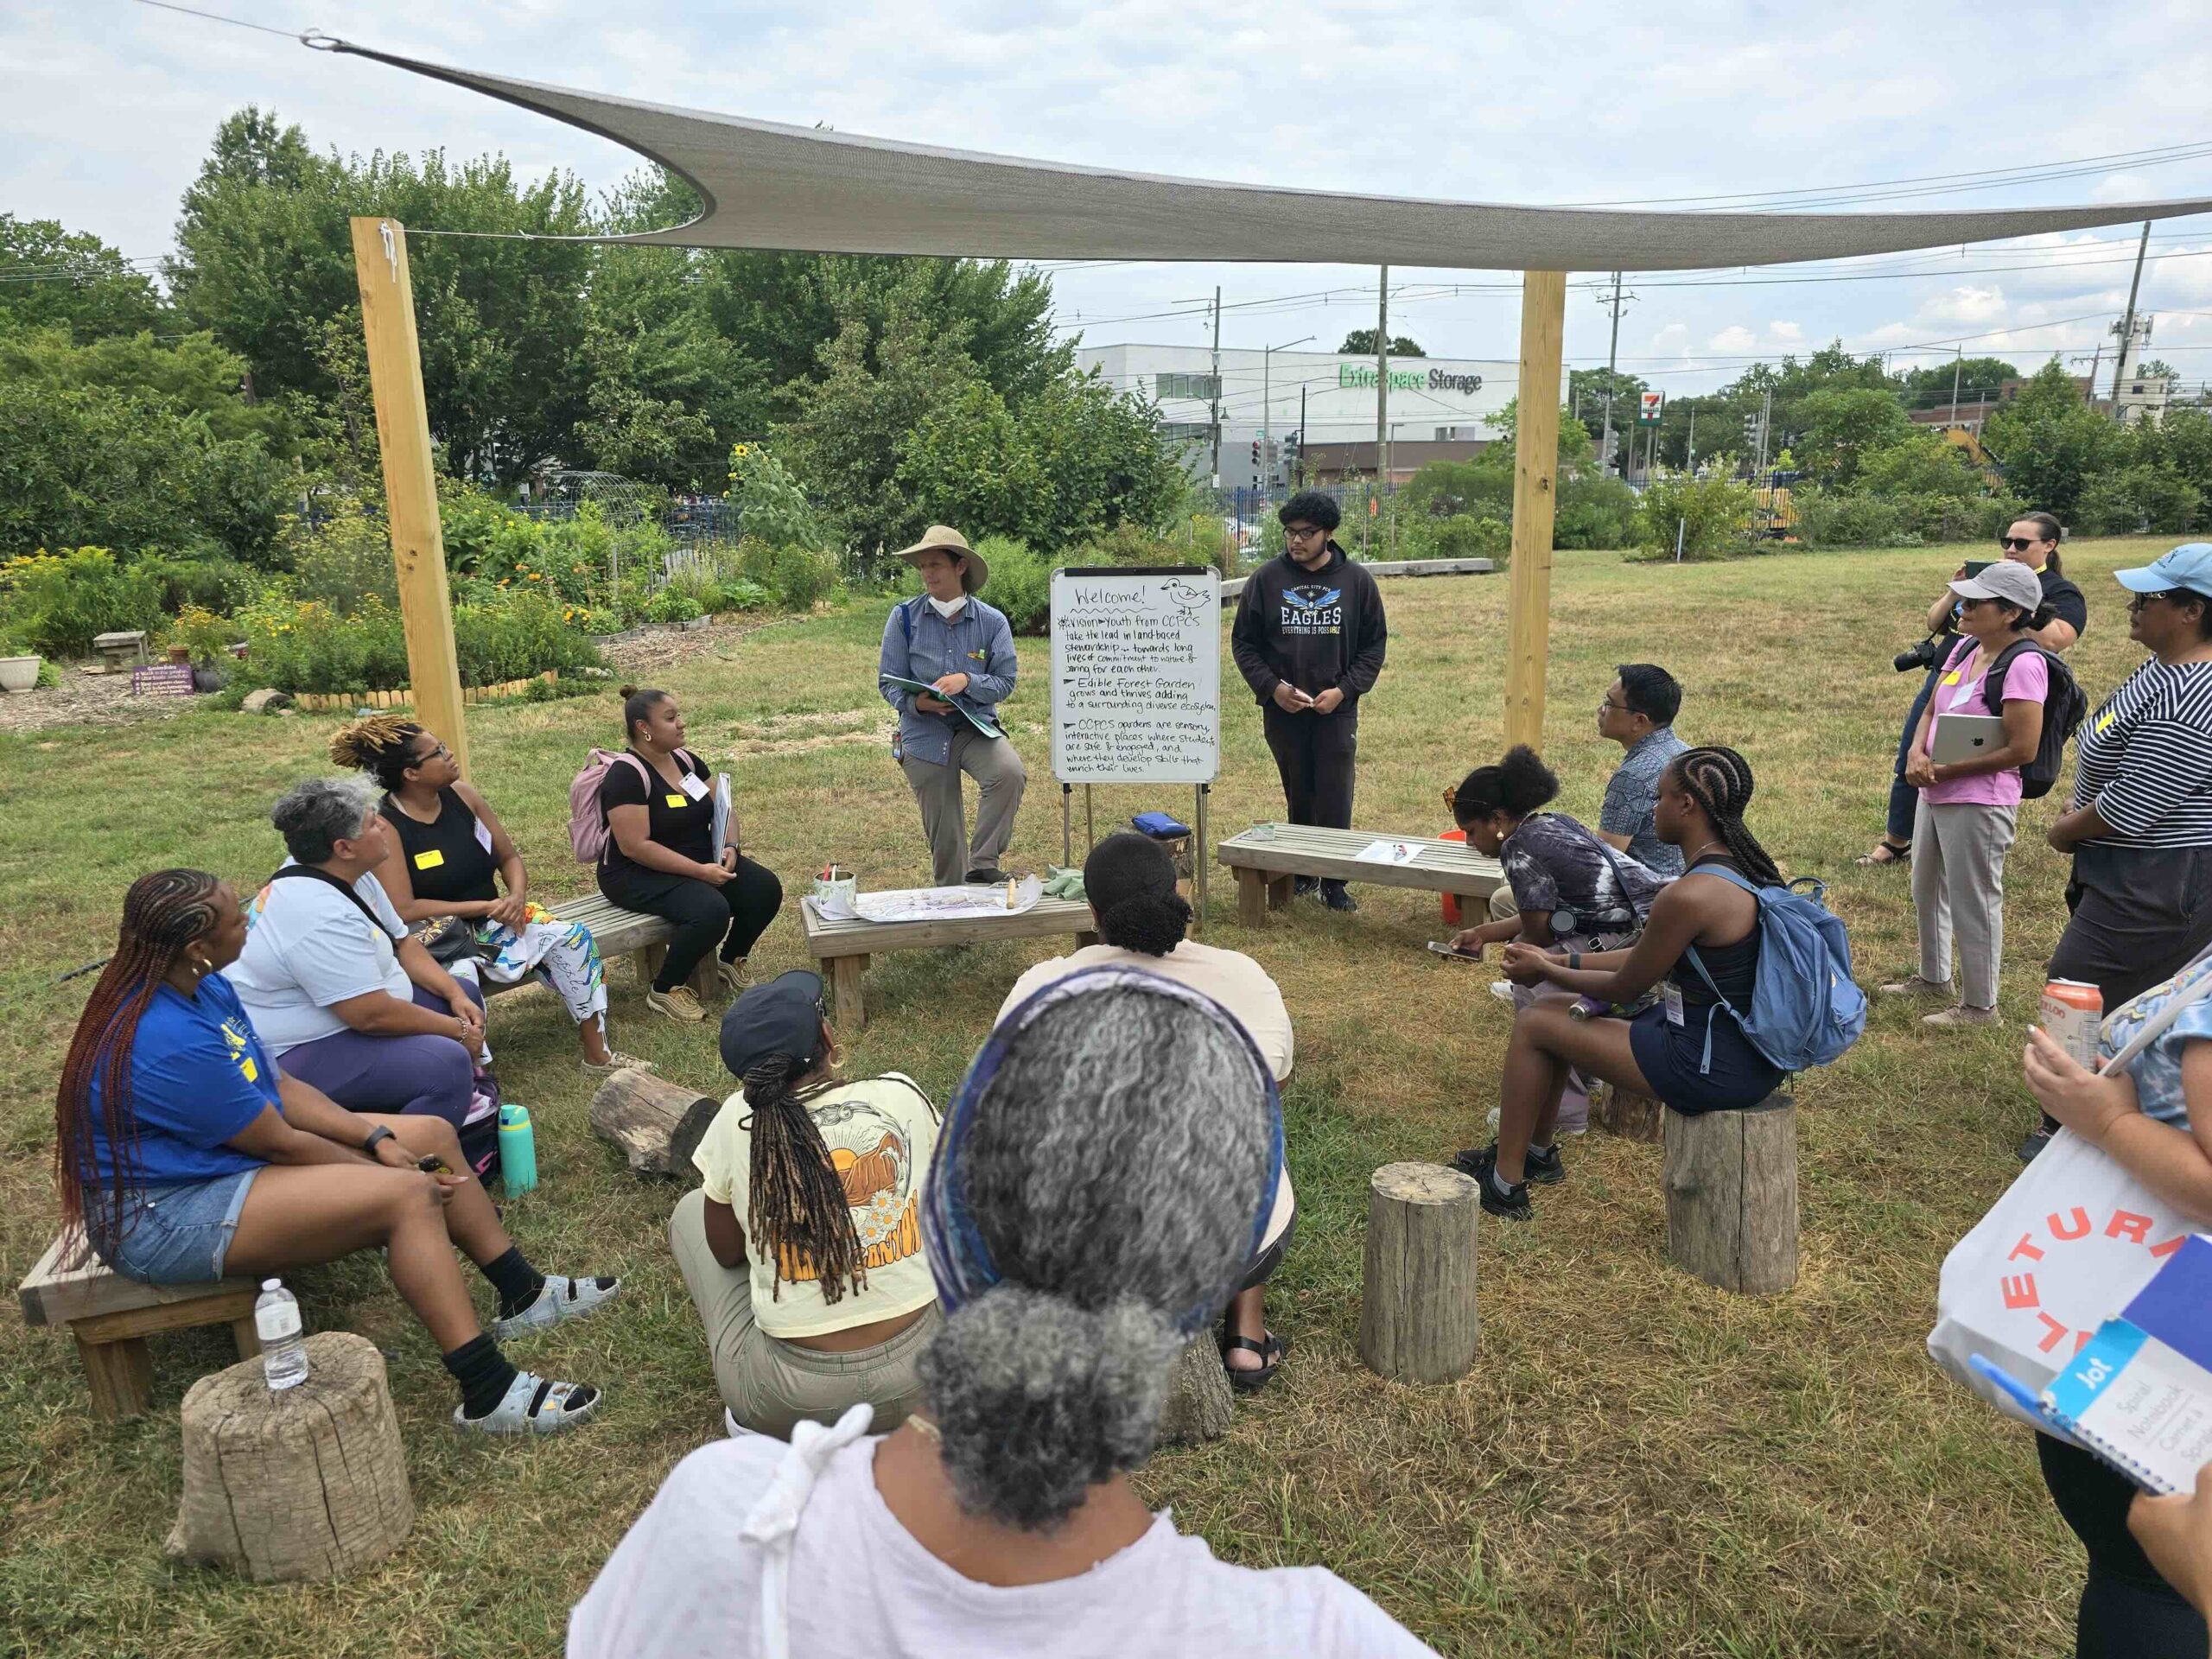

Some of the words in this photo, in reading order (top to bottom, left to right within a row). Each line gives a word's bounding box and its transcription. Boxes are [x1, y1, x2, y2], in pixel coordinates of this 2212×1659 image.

[1428, 368, 1483, 395] Storage
[1075, 585, 1146, 605] Welcome!
[1104, 617, 1132, 628] Youth
[1135, 617, 1159, 627] from
[1281, 606, 1342, 626] EAGLES
[1065, 629, 1084, 641] take
[1085, 629, 1099, 639] the
[1101, 629, 1119, 639] lead
[1123, 631, 1131, 640] in
[1133, 629, 1180, 640] land-based
[1281, 626, 1311, 634] EVERYTHING
[1312, 626, 1317, 634] IS
[1318, 626, 1341, 634] POSSIBLE
[1133, 642, 1171, 653] towards
[1174, 643, 1193, 656] long
[1066, 653, 1086, 663] lives
[1097, 654, 1147, 663] commitment
[1092, 664, 1108, 674] for
[1111, 664, 1135, 674] each
[1077, 677, 1113, 689] Edible
[1116, 677, 1154, 690] Forest
[1154, 677, 1196, 690] Garden
[1069, 690, 1096, 702] grows
[1099, 688, 1118, 696] and
[1121, 688, 1152, 698] thrives
[1154, 689, 1189, 704] adding
[1087, 700, 1144, 715] surrounding
[1146, 700, 1178, 709] diverse
[1117, 721, 1152, 733] gardens
[1065, 732, 1110, 741] interactive
[1114, 733, 1143, 746] places
[1147, 733, 1176, 741] where
[1161, 744, 1182, 753] and
[1065, 754, 1092, 764] where
[1093, 754, 1115, 766] they
[1116, 753, 1153, 766] develop
[1181, 755, 1204, 765] that
[1065, 764, 1094, 773] enrich
[1096, 763, 1119, 772] their
[2075, 1357, 2113, 1390] Jot
[2117, 1380, 2151, 1414] Spiral
[2126, 1384, 2184, 1440] Notebook
